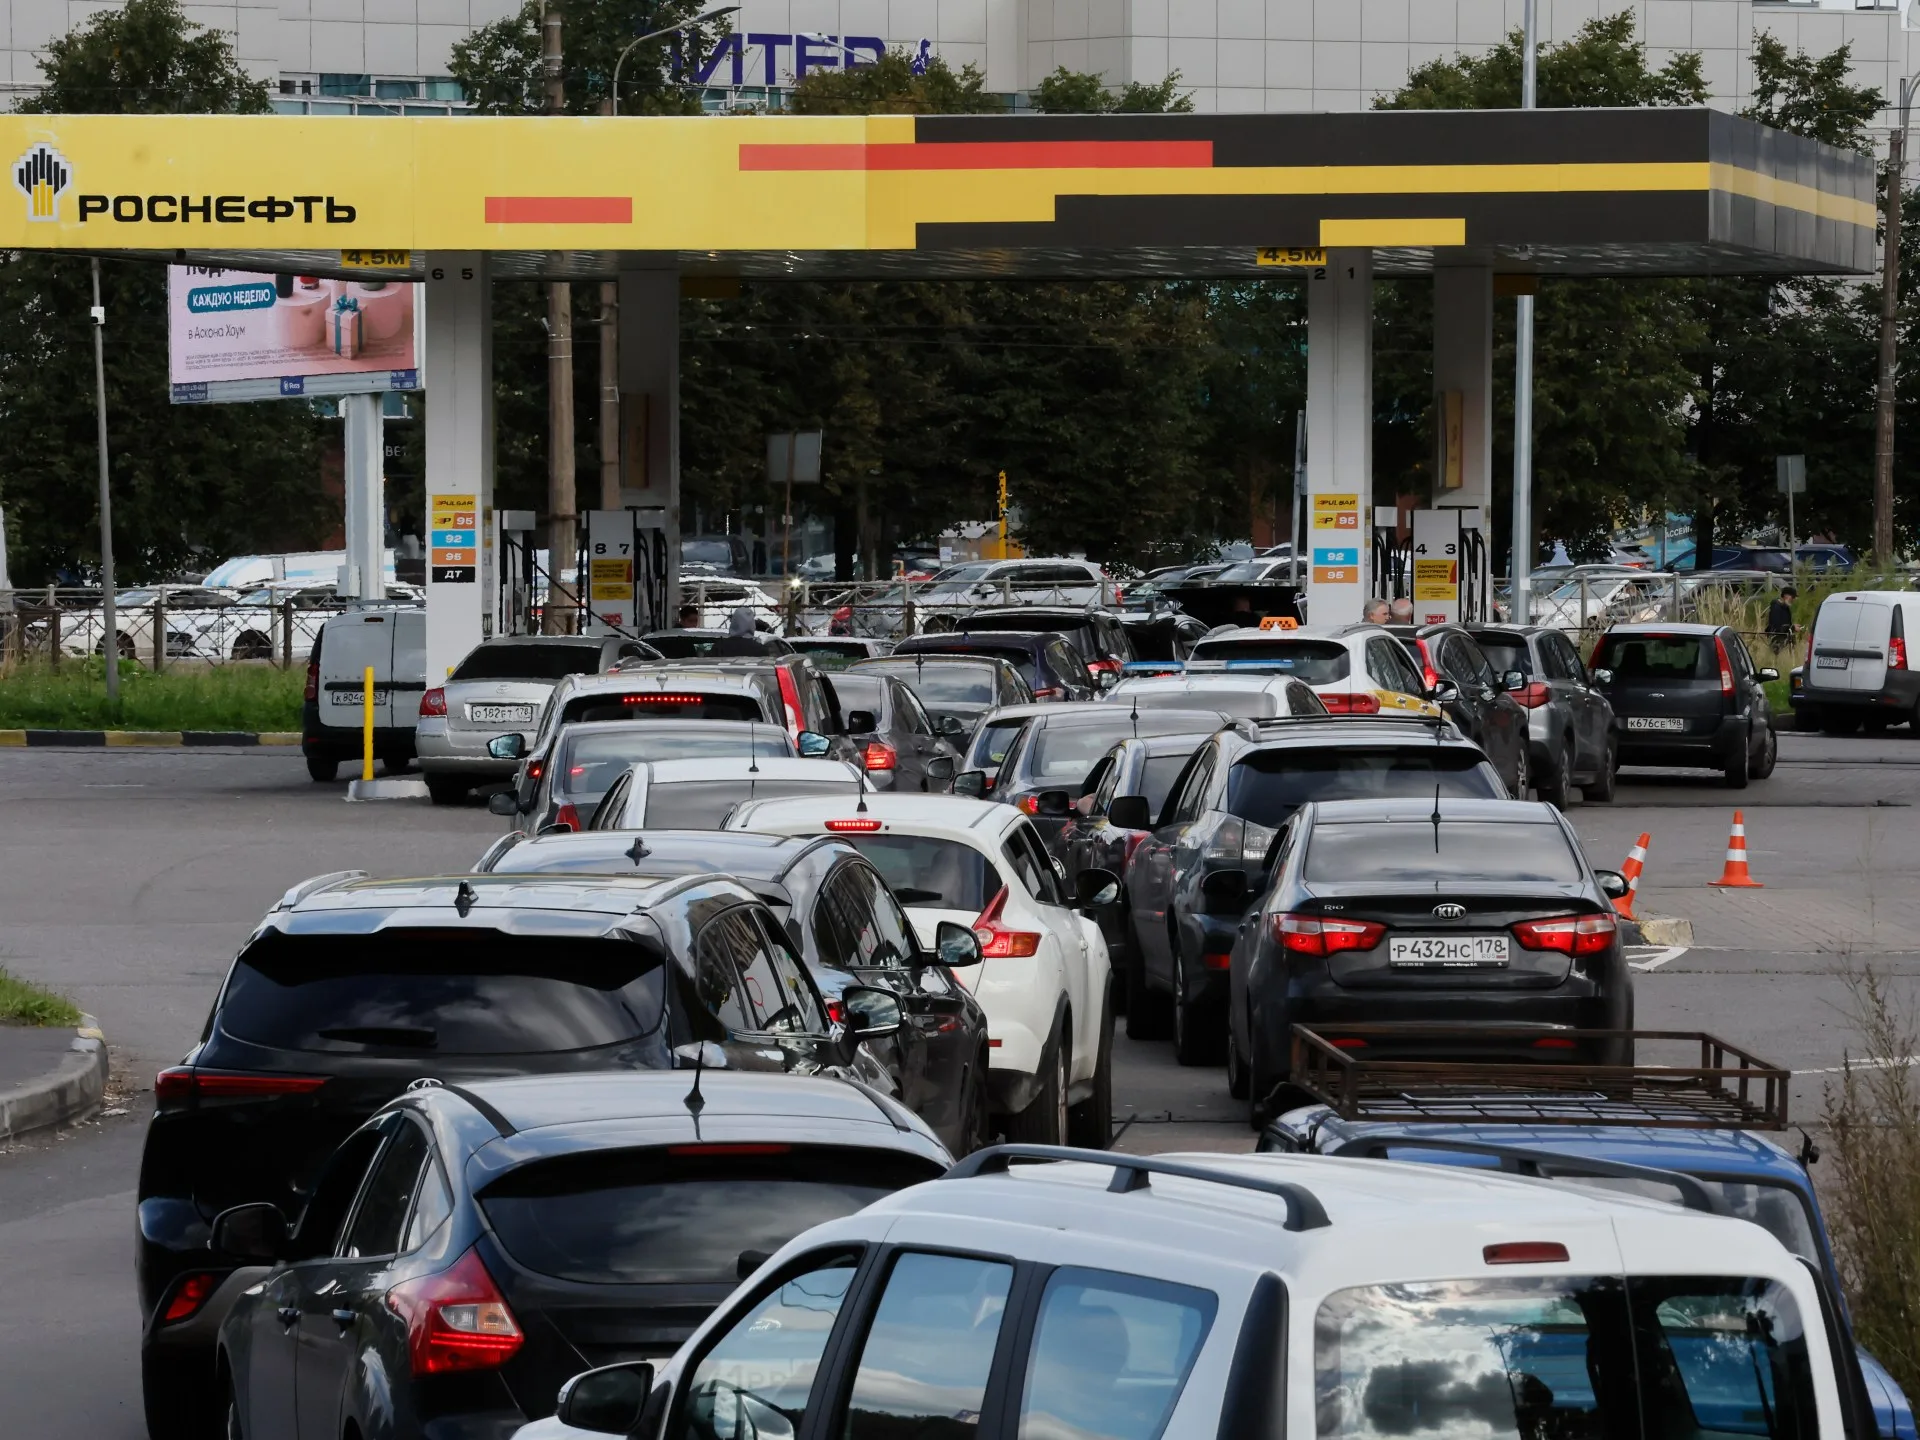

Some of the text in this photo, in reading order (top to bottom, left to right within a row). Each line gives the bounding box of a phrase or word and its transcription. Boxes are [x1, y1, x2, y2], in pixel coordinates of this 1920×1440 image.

[78, 194, 357, 224] РОСНЕФТЬ
[431, 268, 474, 281] 6 5
[1314, 266, 1355, 280] 2 1
[192, 288, 271, 307] КАЖДУЮ НЕДЕЛЮ
[188, 324, 246, 339] в Аскона Хоум
[456, 516, 473, 525] 95
[1338, 516, 1356, 525] 95
[445, 534, 463, 543] 92
[595, 543, 630, 555] 8 7
[1415, 543, 1456, 555] 4 3
[445, 552, 462, 561] 95
[1327, 552, 1345, 561] 92
[444, 570, 463, 579] ДТ
[1327, 571, 1345, 579] 95
[1437, 906, 1462, 917] KIA
[1397, 939, 1503, 958] Р432НС 178
